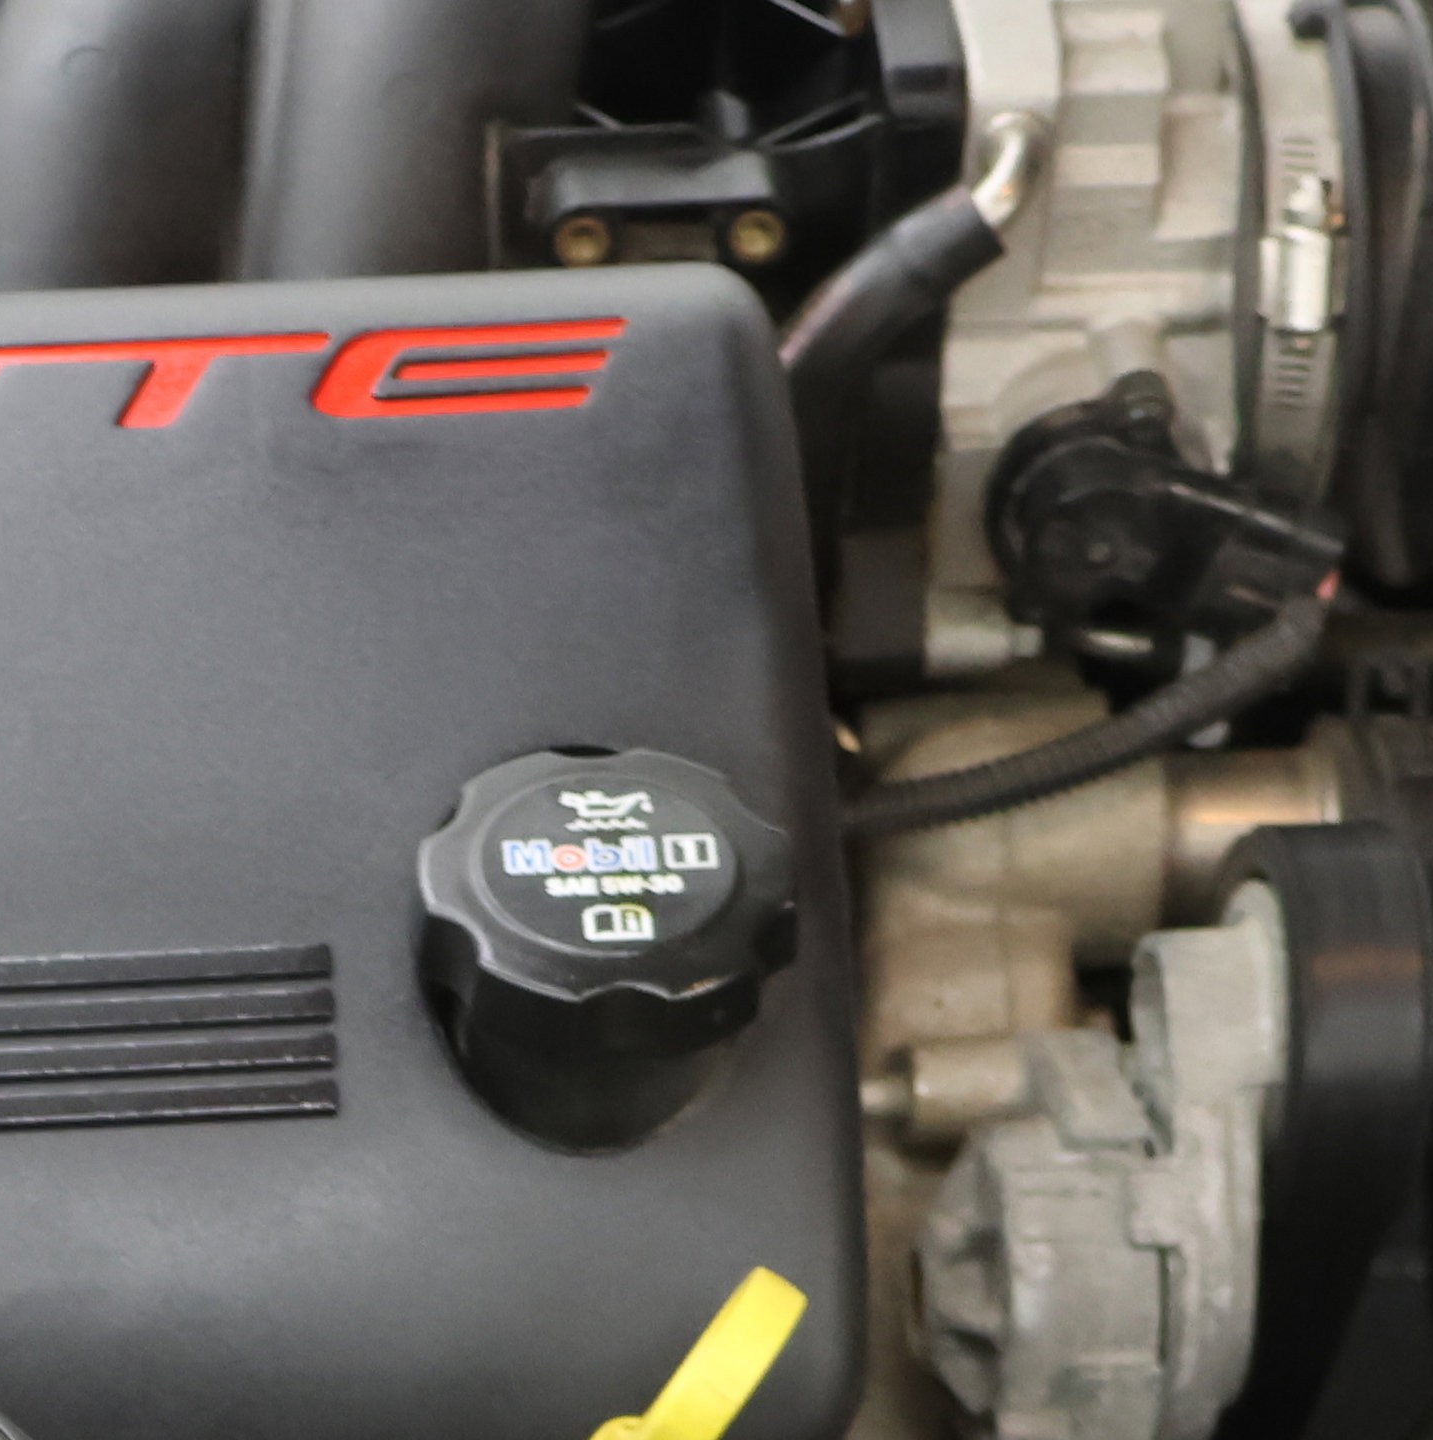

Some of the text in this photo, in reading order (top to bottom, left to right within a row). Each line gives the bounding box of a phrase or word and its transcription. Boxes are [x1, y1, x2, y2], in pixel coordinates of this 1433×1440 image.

[500, 834, 658, 875] Mobil
[544, 873, 685, 897] SAE 5W-30
